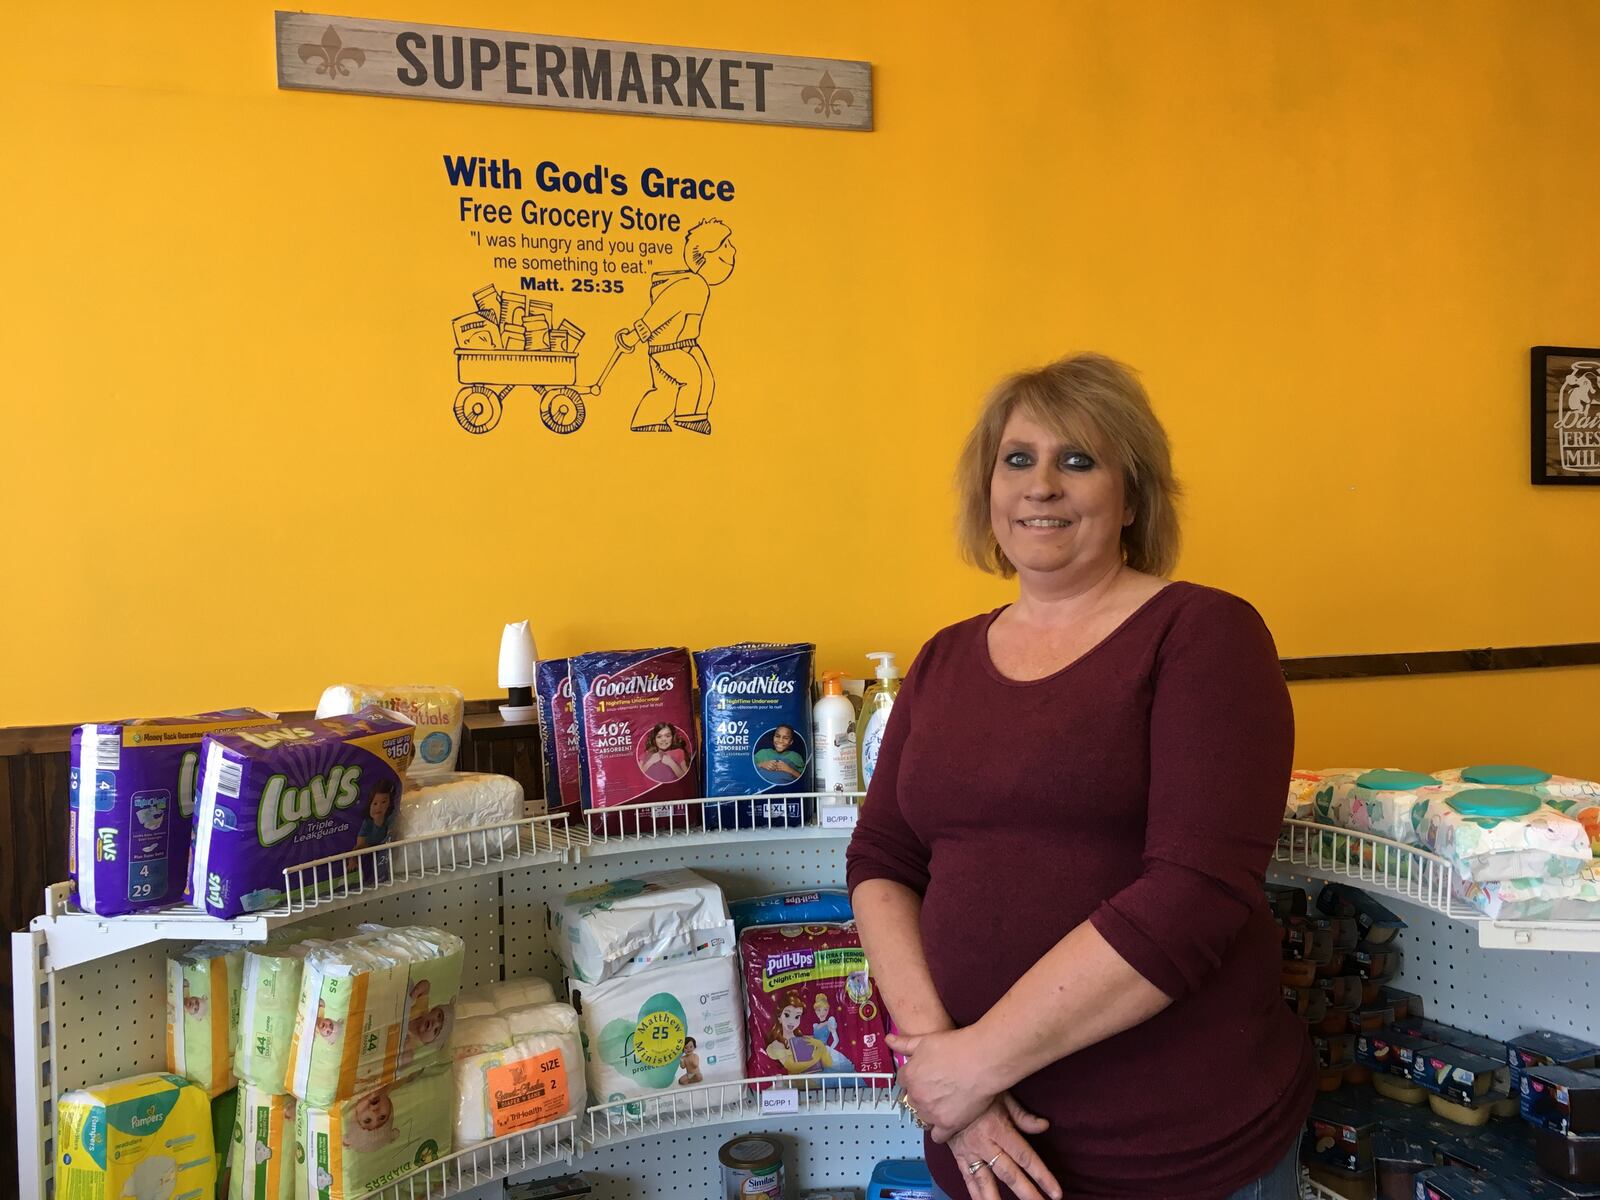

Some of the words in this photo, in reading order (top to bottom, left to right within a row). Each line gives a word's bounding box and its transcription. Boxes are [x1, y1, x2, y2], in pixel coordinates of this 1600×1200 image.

[395, 32, 773, 112] SUPERMARKET
[443, 155, 522, 190] With
[536, 161, 628, 196] God's
[641, 168, 735, 201] Grace
[459, 197, 512, 224] Free
[521, 200, 613, 234] Grocery
[620, 206, 681, 232] Store
[470, 231, 481, 246] "I
[486, 236, 517, 248] was
[522, 234, 571, 254] hungry
[577, 238, 604, 252] and
[609, 242, 634, 257] you
[639, 242, 673, 257] gave
[494, 257, 517, 269] me
[522, 256, 598, 276] something
[603, 260, 616, 273] to
[621, 260, 652, 274] eat."
[520, 277, 564, 292] Matt.
[571, 279, 624, 293] 25:35
[1554, 411, 1600, 429] Dai
[1563, 431, 1600, 447] FRES
[1566, 450, 1600, 466] MIL
[595, 674, 675, 697] GoodNites
[717, 675, 794, 694] GoodNites
[631, 696, 660, 704] Underwear
[598, 721, 631, 737] 40%
[716, 720, 749, 735] 40%
[143, 733, 162, 742] Money
[163, 732, 177, 740] Back
[383, 739, 397, 748] SAVE
[598, 736, 632, 748] MORE
[716, 735, 749, 745] MORE
[387, 743, 410, 758] $150
[70, 772, 78, 790] 29
[100, 781, 110, 790] 4
[257, 765, 362, 848] Luvs
[214, 808, 226, 827] 29
[307, 818, 334, 833] Triple
[293, 822, 349, 843] Leakguards
[140, 865, 149, 877] 4
[132, 884, 151, 898] 29
[785, 893, 819, 904] Pull-Ups
[767, 952, 813, 976] Pull-Ups
[637, 1013, 682, 1034] Matthew
[652, 1026, 669, 1039] 25
[256, 1036, 266, 1055] 44
[368, 1033, 378, 1051] 44
[635, 1038, 684, 1064] Ministries
[540, 1058, 561, 1073] SIZE
[550, 1080, 557, 1089] 2
[131, 1111, 163, 1129] Pampers
[89, 1115, 99, 1151] Pampers
[365, 1161, 411, 1192] DIAPERS
[748, 1176, 776, 1187] Similac
